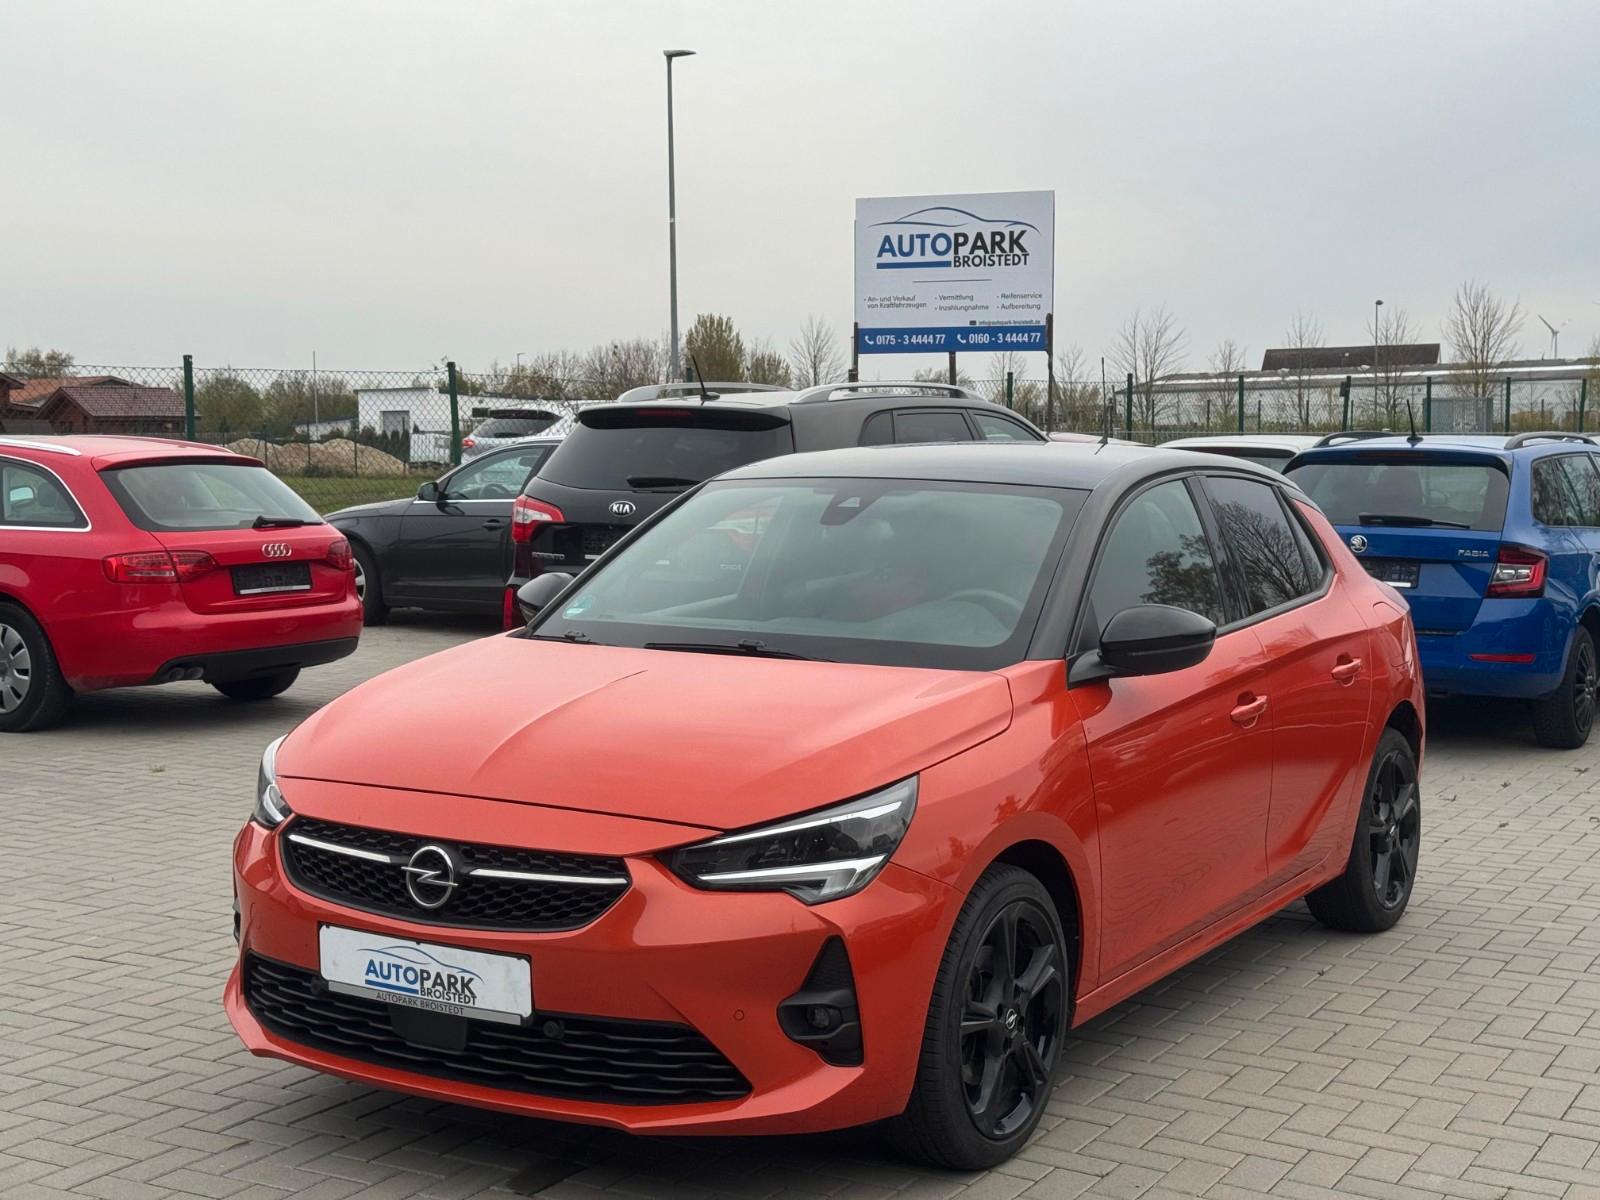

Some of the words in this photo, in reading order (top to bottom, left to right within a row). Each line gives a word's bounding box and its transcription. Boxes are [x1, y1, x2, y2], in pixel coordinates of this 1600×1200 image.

[876, 230, 1029, 258] AUTOPARK
[953, 253, 1030, 268] BROISTEDT
[938, 294, 974, 302] Vermittlung
[880, 302, 927, 310] Kraftfahrzeugen
[939, 304, 989, 312] Inzahlungnahme
[1000, 303, 1041, 311] Aufbereitung
[876, 335, 896, 345] 0175
[903, 334, 909, 345] 3
[968, 333, 990, 344] 0160
[997, 333, 1004, 344] 3
[612, 503, 630, 514] KIA
[1457, 549, 1490, 558] FABIA
[365, 959, 477, 997] AUTOPARK
[420, 987, 478, 1006] BROISTEDT
[376, 991, 418, 1007] AUTOPARK
[419, 1001, 465, 1015] BROISTEDT
